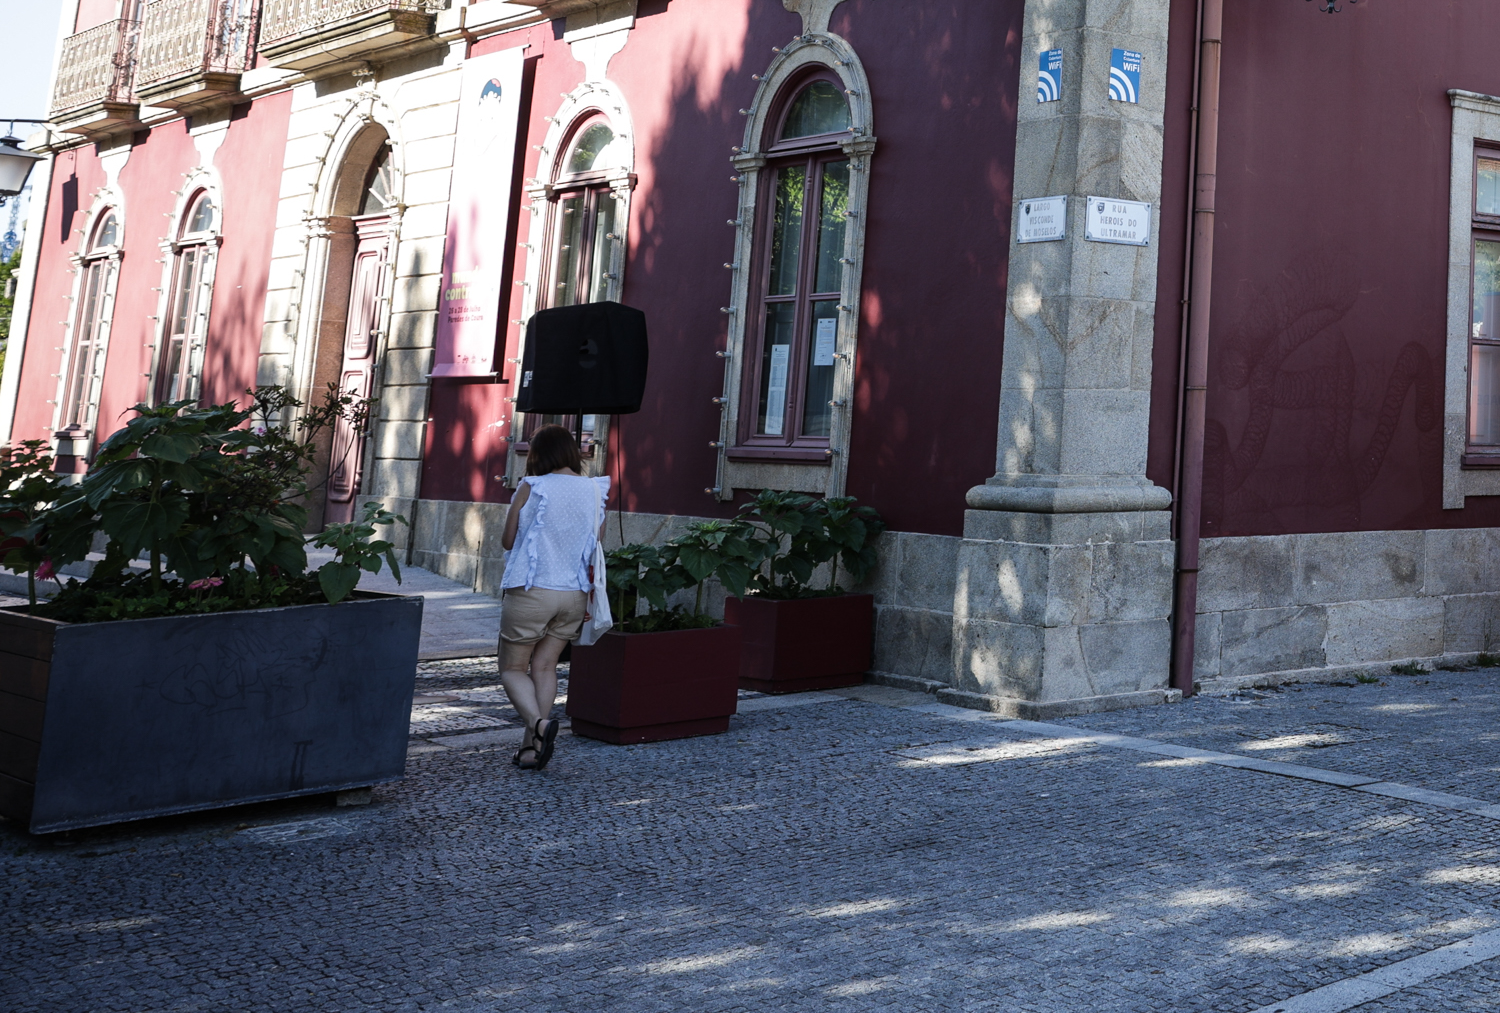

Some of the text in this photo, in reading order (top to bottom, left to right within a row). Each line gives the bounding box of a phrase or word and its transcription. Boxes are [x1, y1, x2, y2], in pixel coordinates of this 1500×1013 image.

[1049, 61, 1061, 70] WiFi
[1123, 62, 1139, 72] WiFi
[1034, 203, 1050, 212] LARGO
[1112, 205, 1127, 214] RUA
[1029, 216, 1054, 225] VISCONDE
[1128, 219, 1137, 227] DO
[1025, 229, 1031, 237] DE
[1101, 229, 1136, 239] ULTRAMAR
